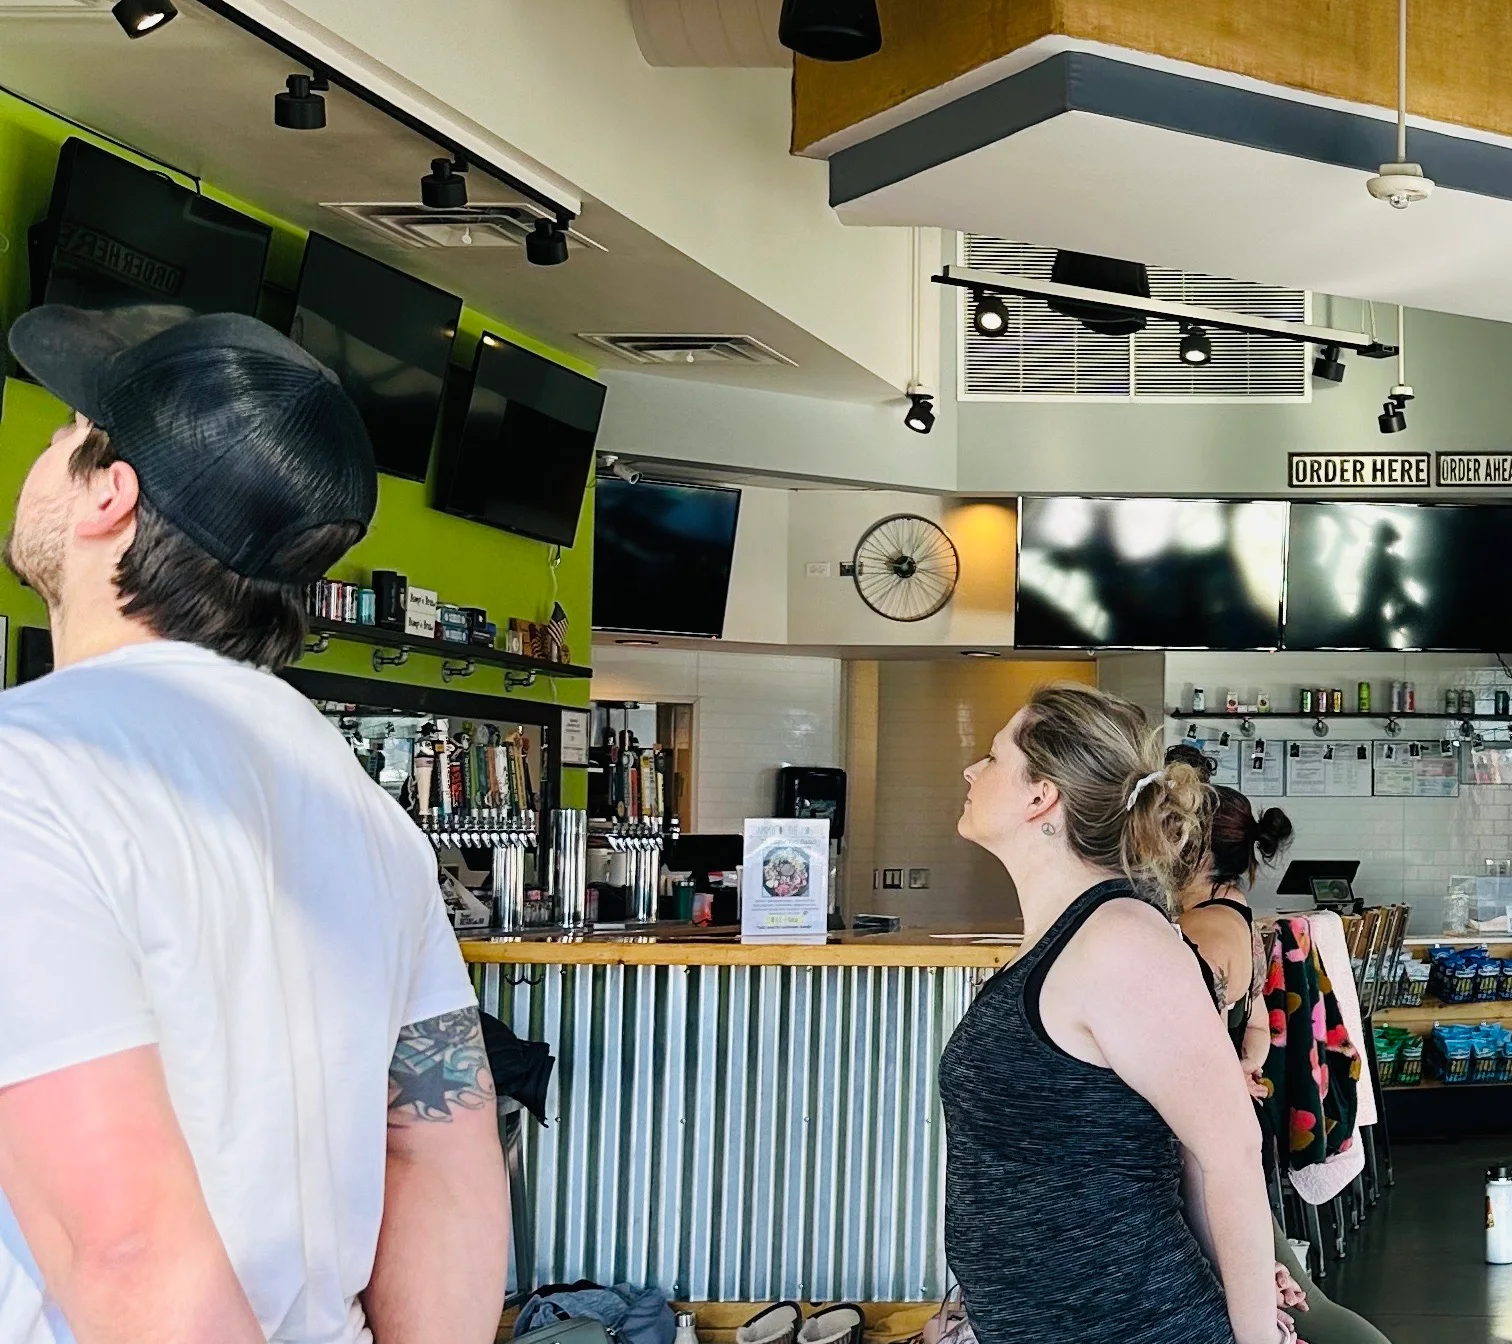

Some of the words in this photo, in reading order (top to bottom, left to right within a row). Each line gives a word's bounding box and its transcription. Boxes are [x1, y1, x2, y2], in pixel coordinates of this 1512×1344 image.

[1295, 459, 1365, 483] ORDER
[1372, 459, 1426, 483] HERE
[1442, 458, 1480, 481] ORDER
